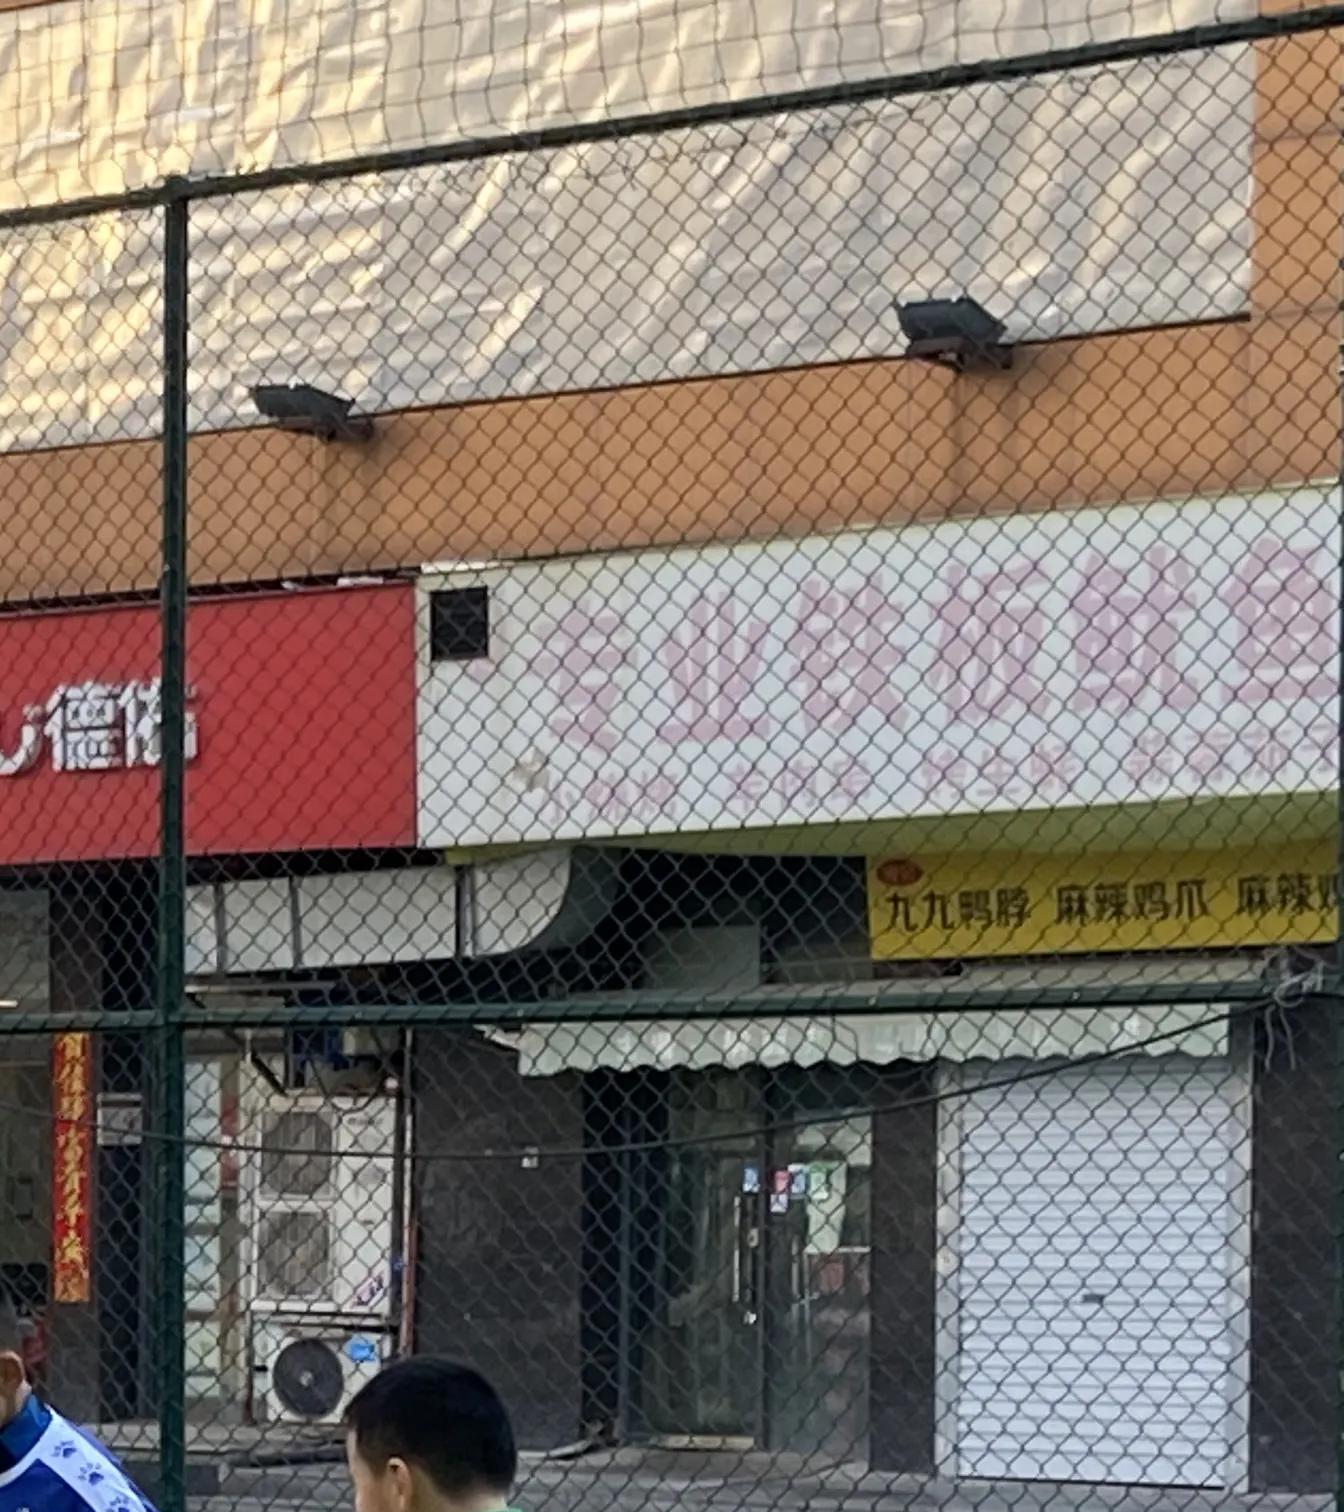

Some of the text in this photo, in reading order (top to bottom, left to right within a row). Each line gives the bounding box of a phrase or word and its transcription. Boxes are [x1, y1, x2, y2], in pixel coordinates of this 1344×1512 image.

[886, 887, 1031, 931] 九九鸭脖
[1055, 878, 1208, 924] 麻辣鸡爪
